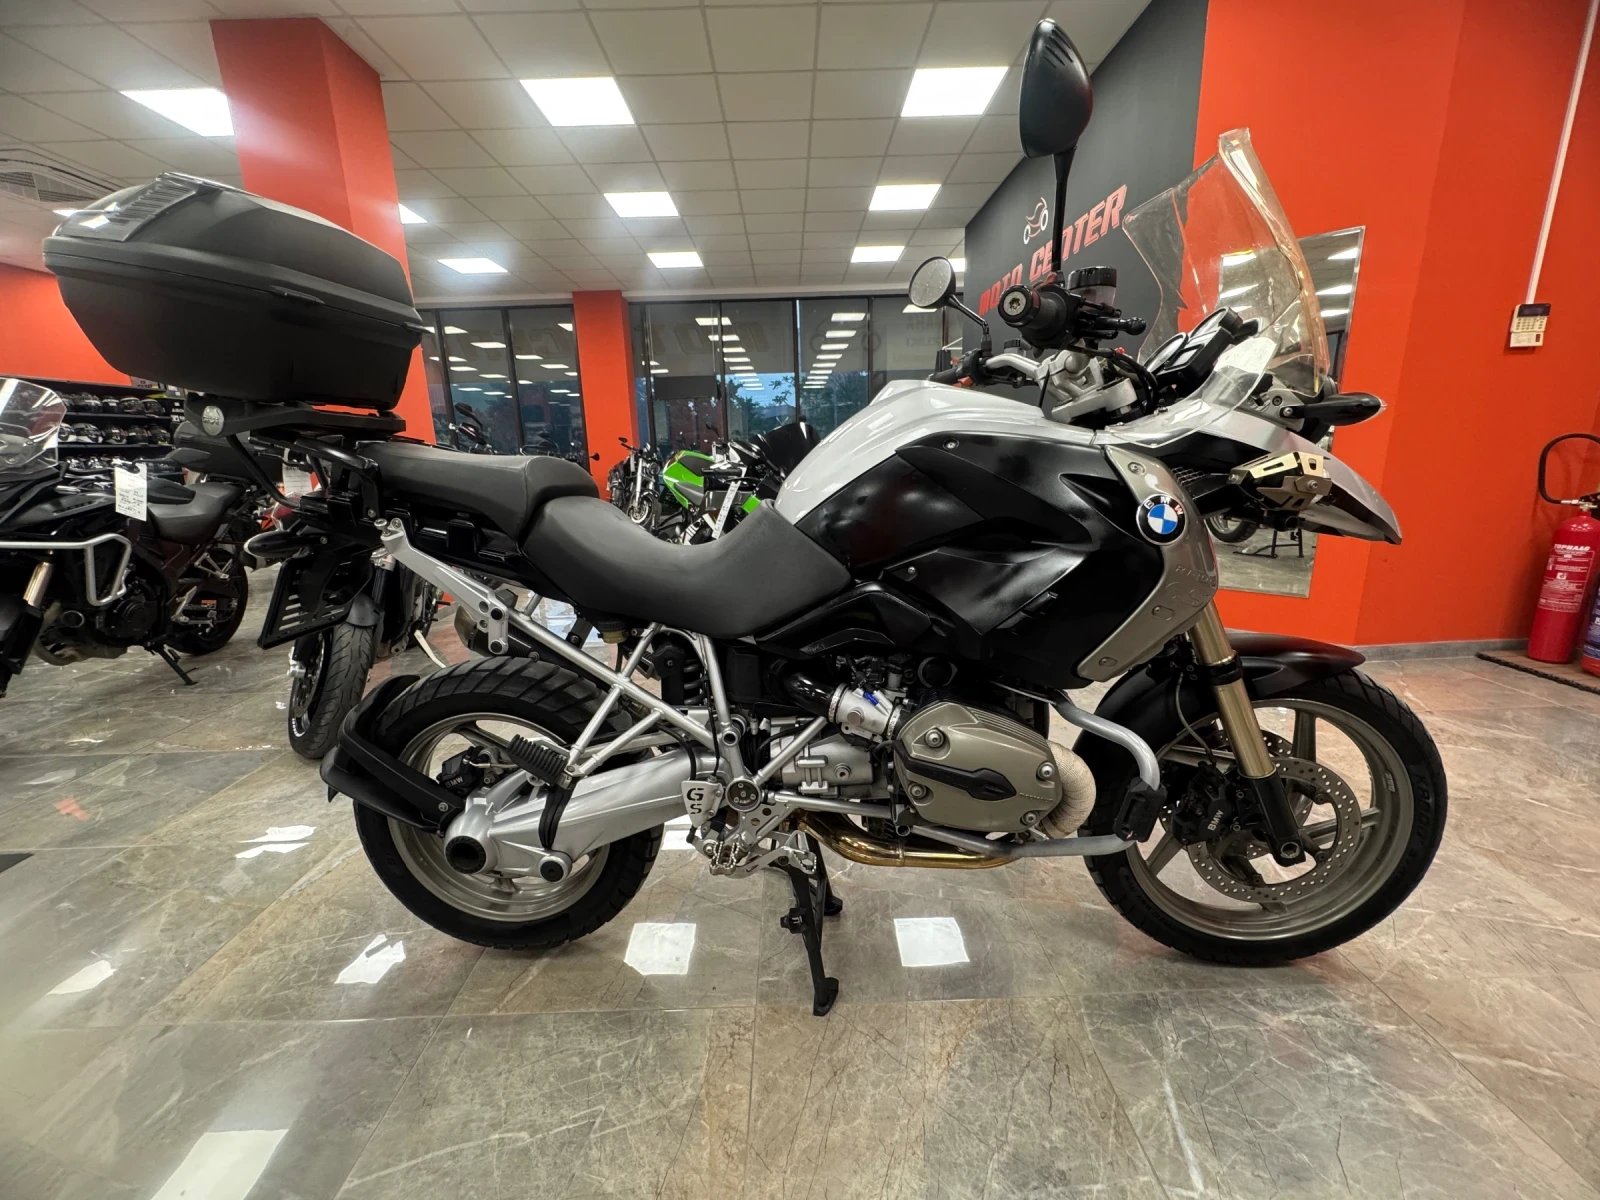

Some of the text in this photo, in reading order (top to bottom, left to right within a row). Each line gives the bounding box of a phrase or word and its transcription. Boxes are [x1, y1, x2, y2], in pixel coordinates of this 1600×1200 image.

[1029, 184, 1128, 282] CENTER
[1144, 496, 1184, 516] BMW
[445, 775, 464, 788] BMW
[1204, 809, 1224, 831] BMW
